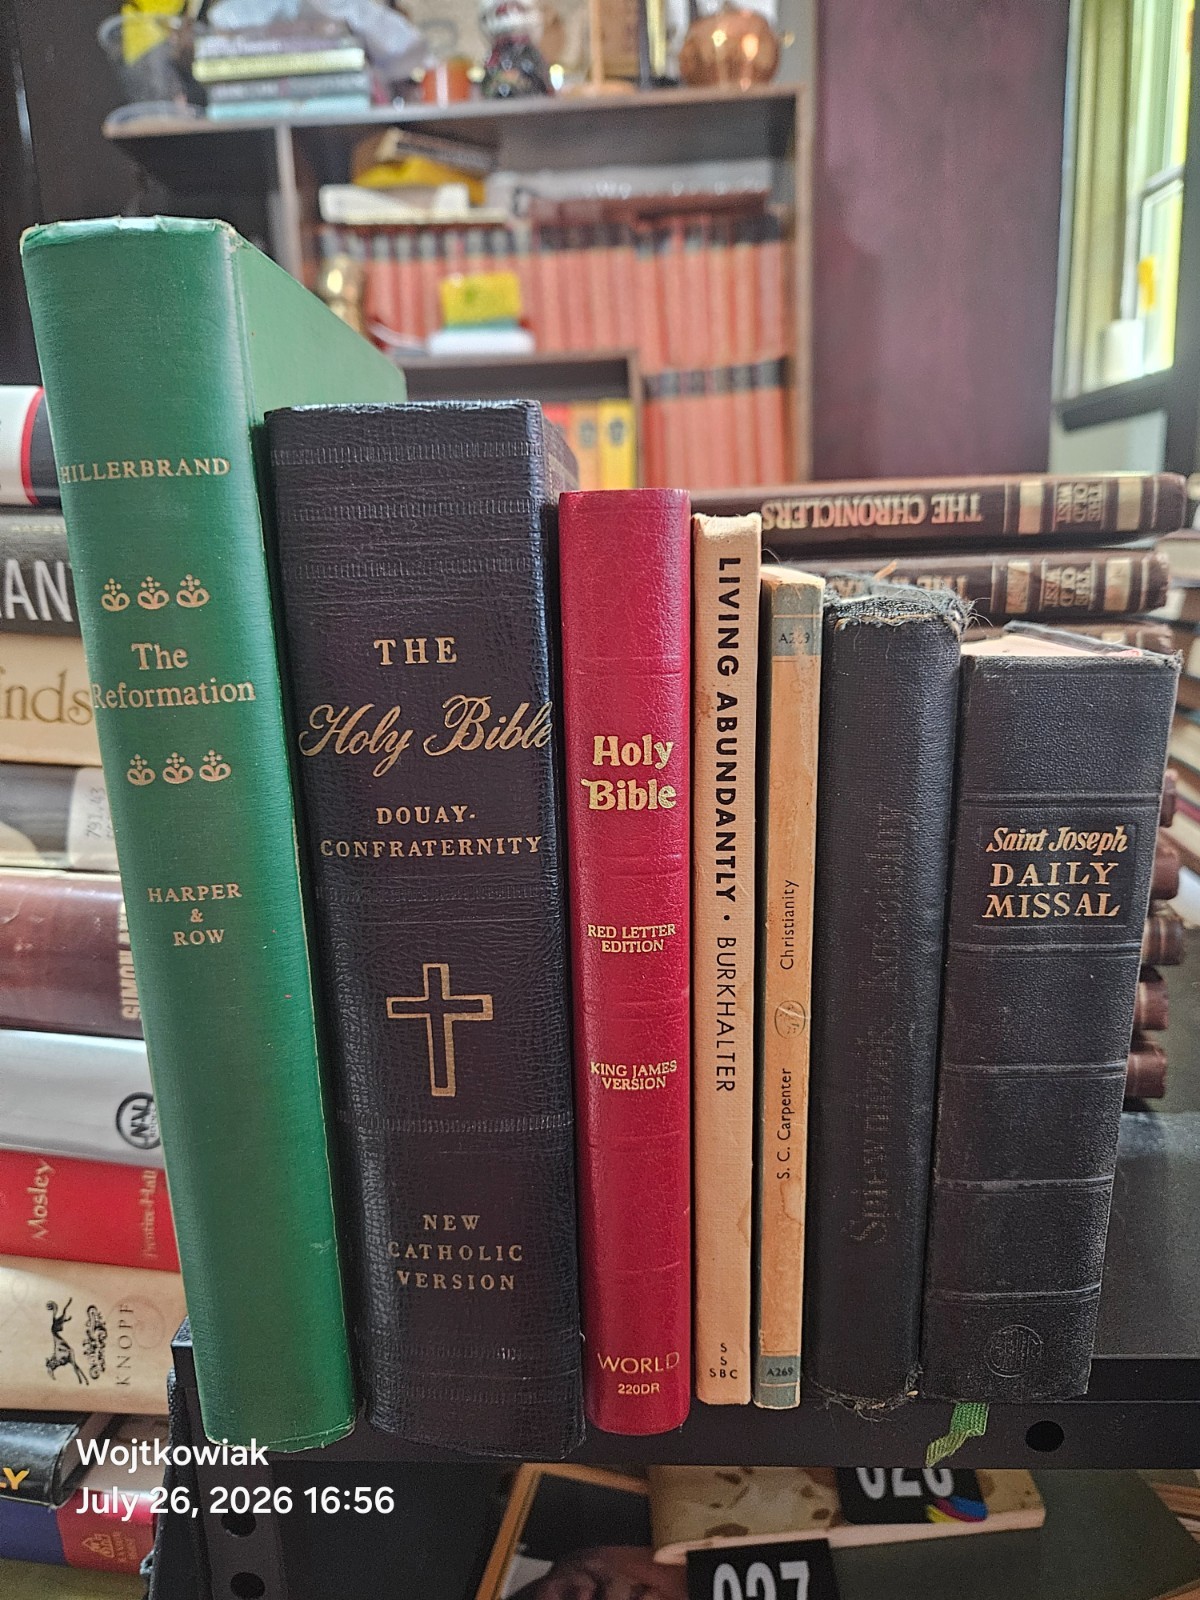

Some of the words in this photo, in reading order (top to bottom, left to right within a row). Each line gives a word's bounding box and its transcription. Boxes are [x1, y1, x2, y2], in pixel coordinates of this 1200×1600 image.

[60, 457, 231, 483] HILLERBRAND
[761, 494, 927, 530] CHRONICLERS
[931, 492, 983, 523] THE
[717, 558, 741, 676] LIVING
[131, 643, 189, 670] The
[373, 637, 457, 665] THE
[92, 677, 256, 709] Reformation
[299, 703, 413, 778] Holy
[423, 695, 552, 757] Bible
[592, 734, 674, 769] Holy
[581, 779, 677, 810] Bible
[715, 692, 738, 903] ABUNDANTLY
[320, 836, 541, 858] CONFRATERNITY
[986, 827, 1049, 852] Saint
[1049, 825, 1128, 856] Joseph
[990, 862, 1119, 886] DAILY
[149, 883, 242, 902] HARPER
[190, 908, 204, 923] &
[981, 893, 1120, 918] MISSAL
[587, 924, 617, 938] RED
[622, 924, 676, 938] LETTER
[780, 879, 799, 970] Christianity
[173, 929, 225, 946] ROW
[602, 939, 664, 953] EDITION
[716, 937, 737, 1092] BURKHALTER
[590, 1061, 628, 1078] KING
[632, 1060, 677, 1078] JAMES
[601, 1076, 667, 1091] VERSION
[777, 1068, 793, 1140] Carpenter
[777, 1147, 790, 1163] C.
[777, 1167, 790, 1180] S.
[27, 1159, 55, 1241] Mosley
[423, 1215, 480, 1230] NEW
[388, 1242, 523, 1262] CATHOLIC
[397, 1271, 515, 1290] VERSION
[115, 1303, 133, 1386] KNOPF
[720, 1342, 727, 1353] S
[597, 1352, 680, 1374] WORLD
[720, 1356, 727, 1366] S
[766, 1367, 794, 1377] A269
[618, 1383, 660, 1395] 220DR
